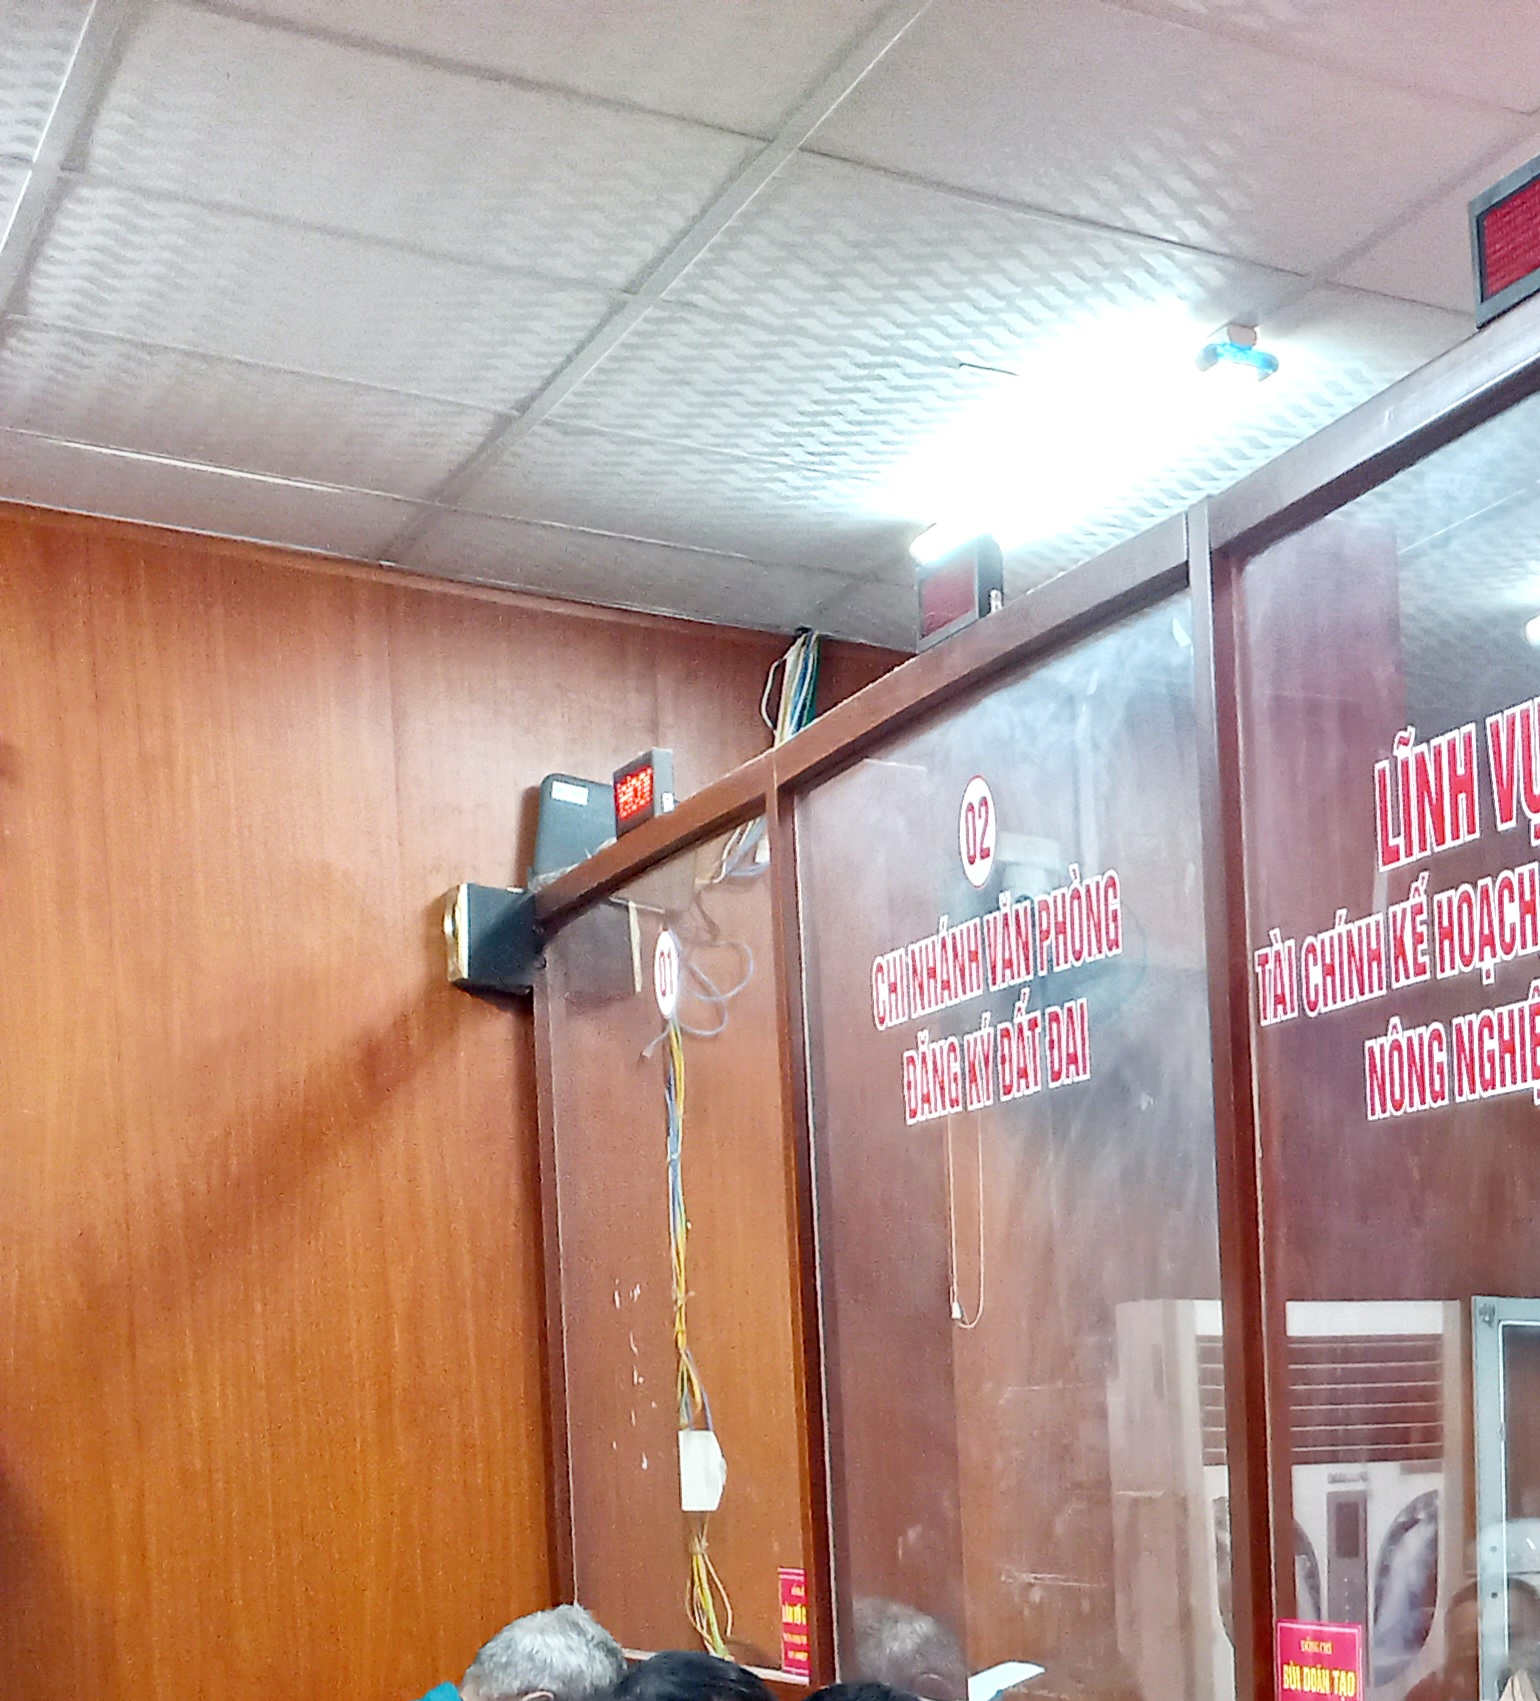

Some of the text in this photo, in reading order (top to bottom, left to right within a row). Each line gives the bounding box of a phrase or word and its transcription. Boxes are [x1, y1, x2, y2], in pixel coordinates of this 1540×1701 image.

[964, 797, 991, 866] 02
[1373, 722, 1479, 873] LĨNH
[658, 946, 674, 999] 01
[871, 863, 1123, 1031] CHI NHÁNH VĂN PHÒNG
[1255, 930, 1298, 1025] TÀI
[1302, 908, 1385, 1017] CHÍNH
[1391, 873, 1429, 990] KẾ
[901, 990, 1092, 1126] ĐĂNG KÝ ĐẤT ĐAI
[1364, 1017, 1446, 1120] NÔNG
